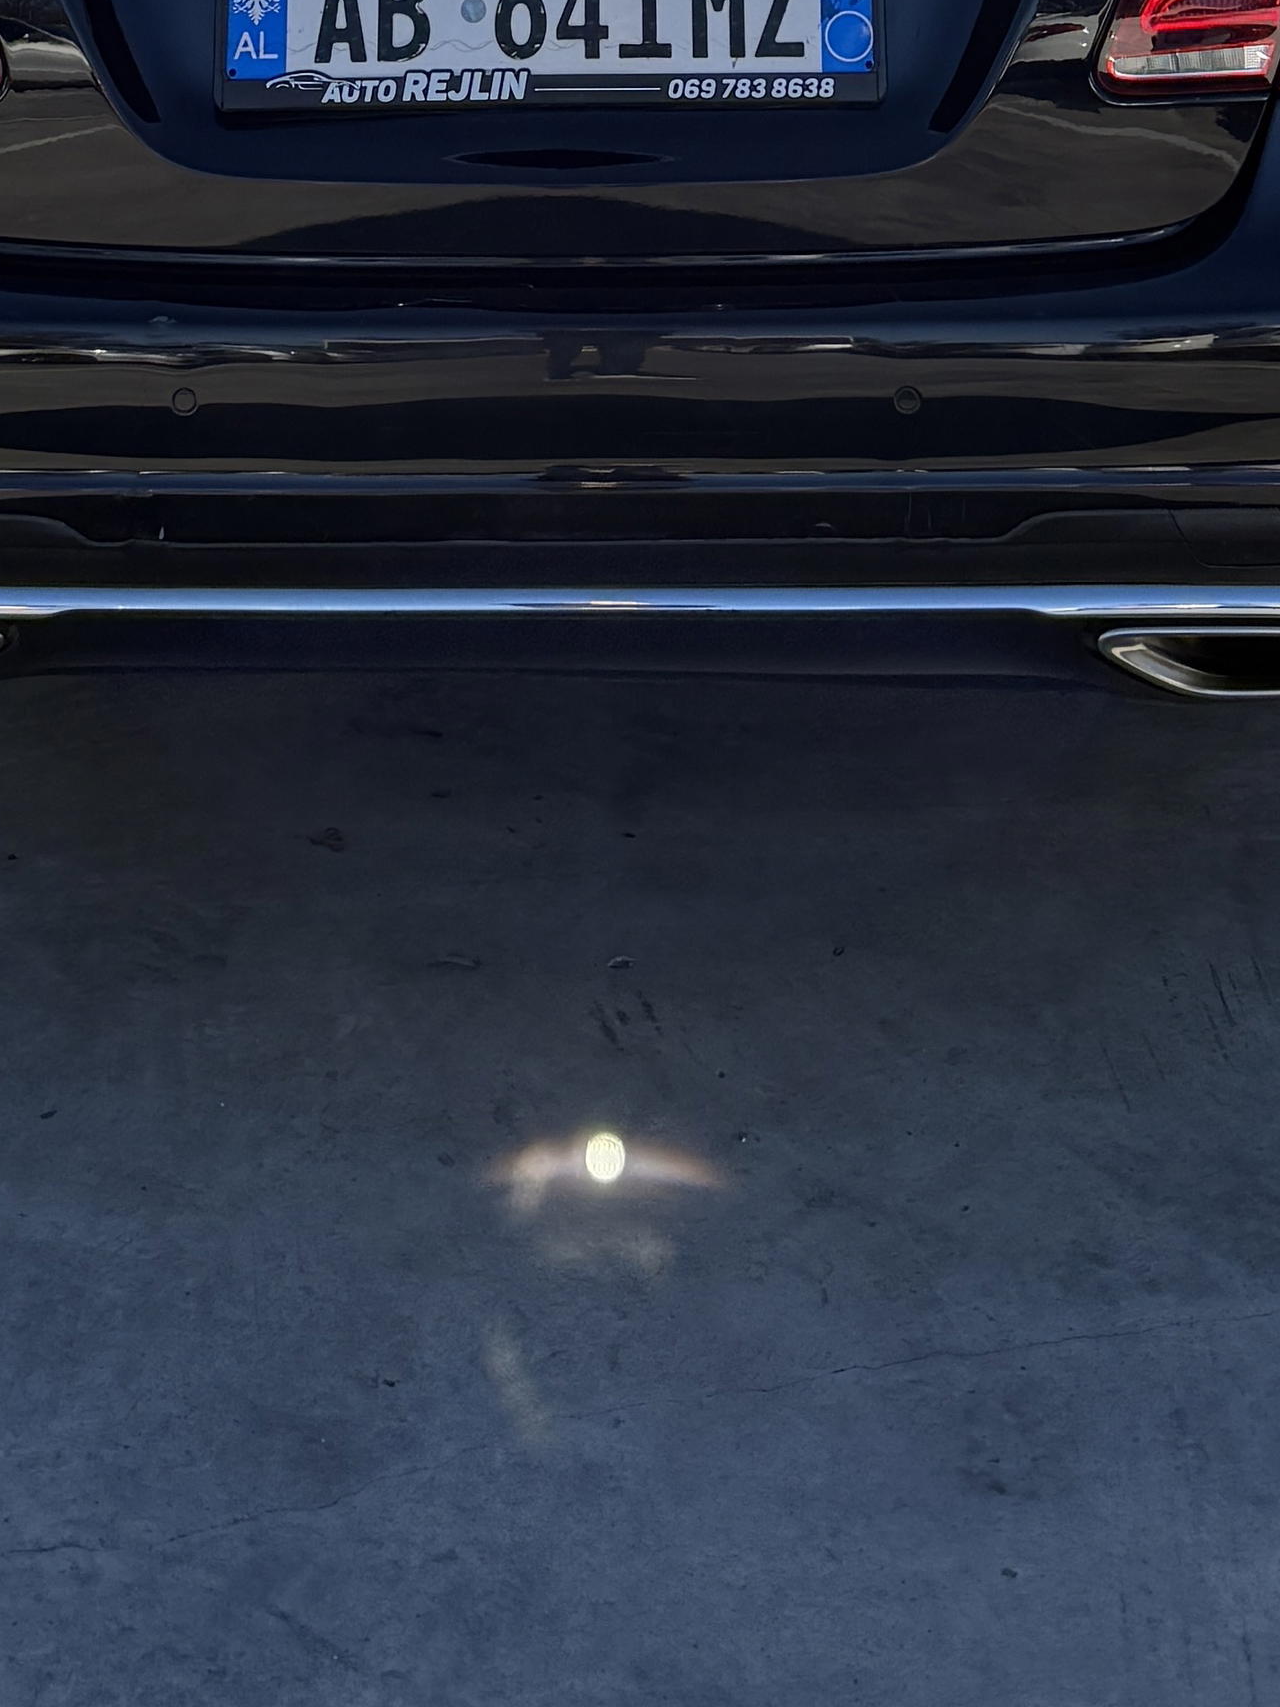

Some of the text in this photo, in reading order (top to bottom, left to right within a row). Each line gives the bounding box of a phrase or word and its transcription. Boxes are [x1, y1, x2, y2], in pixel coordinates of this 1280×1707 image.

[234, 32, 279, 61] AL
[321, 71, 836, 104] AUTO REJLIN 069 783 8638
